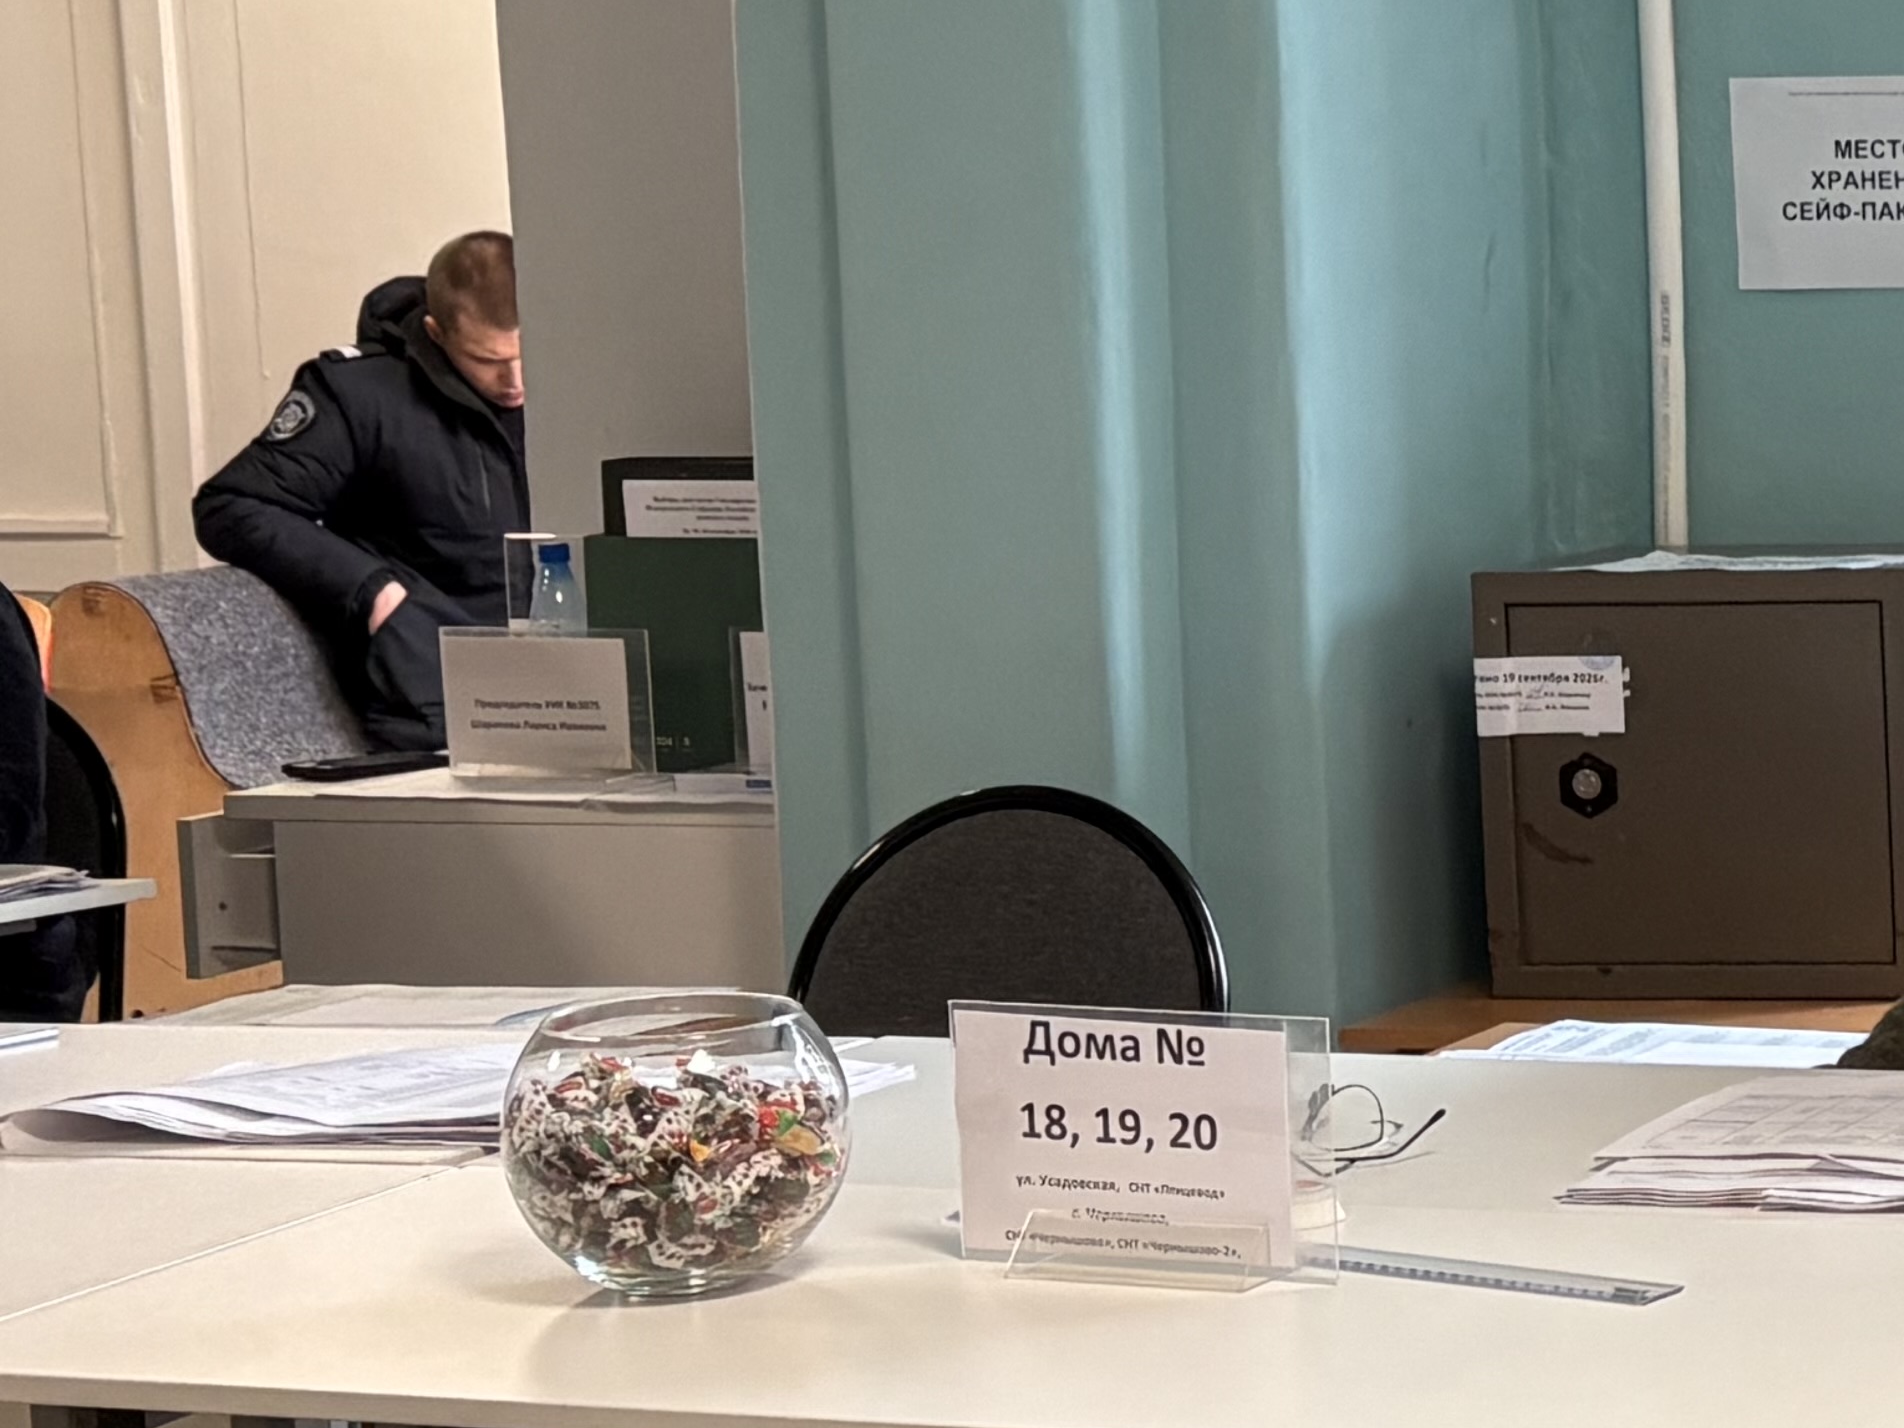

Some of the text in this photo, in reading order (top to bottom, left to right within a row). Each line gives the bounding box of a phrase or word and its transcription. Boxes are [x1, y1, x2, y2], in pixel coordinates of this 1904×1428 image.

[1503, 672, 1516, 683] 19
[1022, 1019, 1206, 1067] Дома №
[1020, 1102, 1218, 1154] 18, 19, 20
